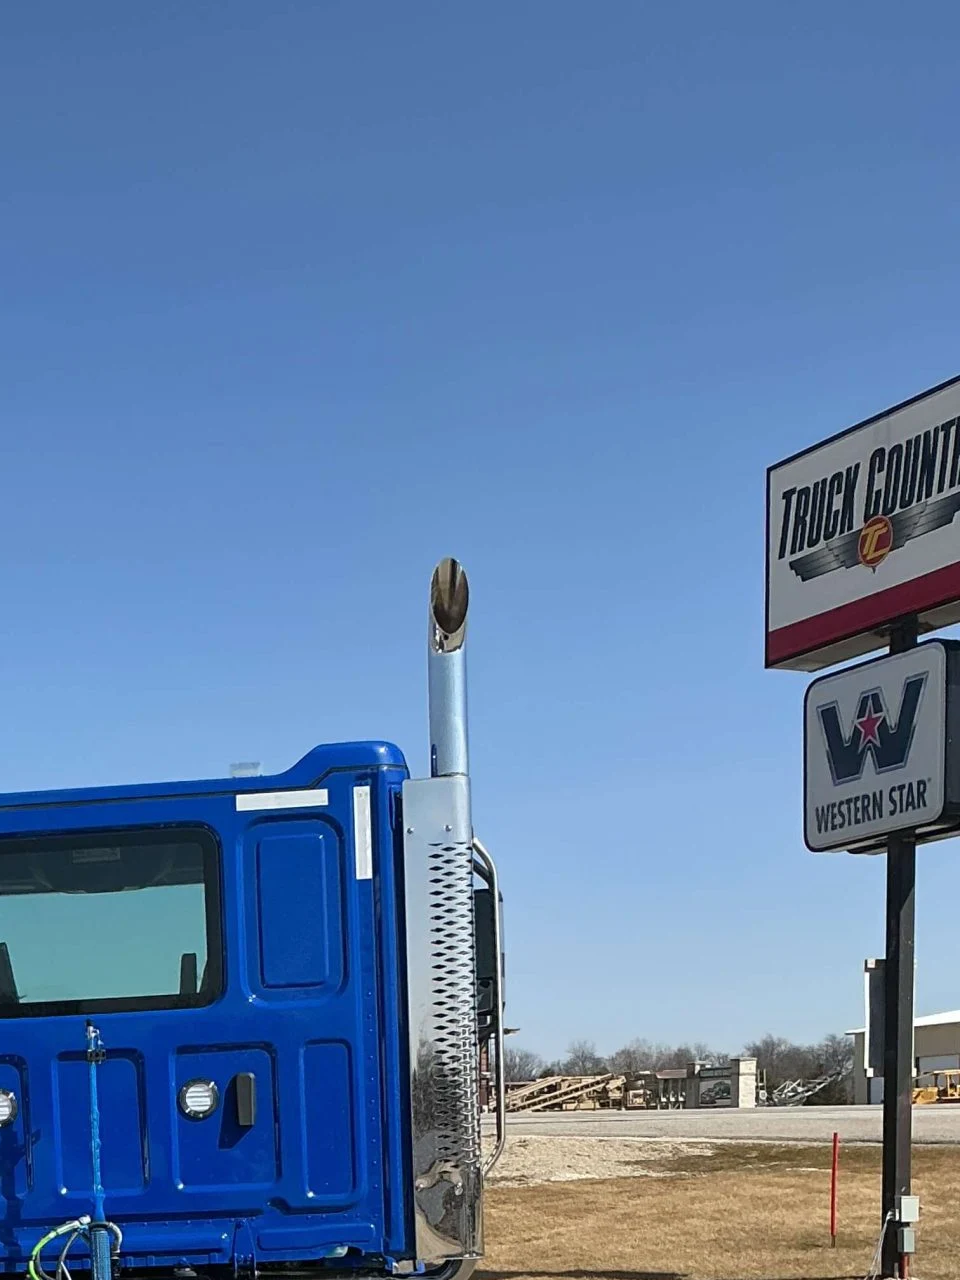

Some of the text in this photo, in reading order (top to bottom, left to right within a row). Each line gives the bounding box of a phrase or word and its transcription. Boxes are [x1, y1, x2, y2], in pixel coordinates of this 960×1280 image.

[778, 462, 861, 560] TRUCK
[815, 779, 927, 834] WESTERN STAR
